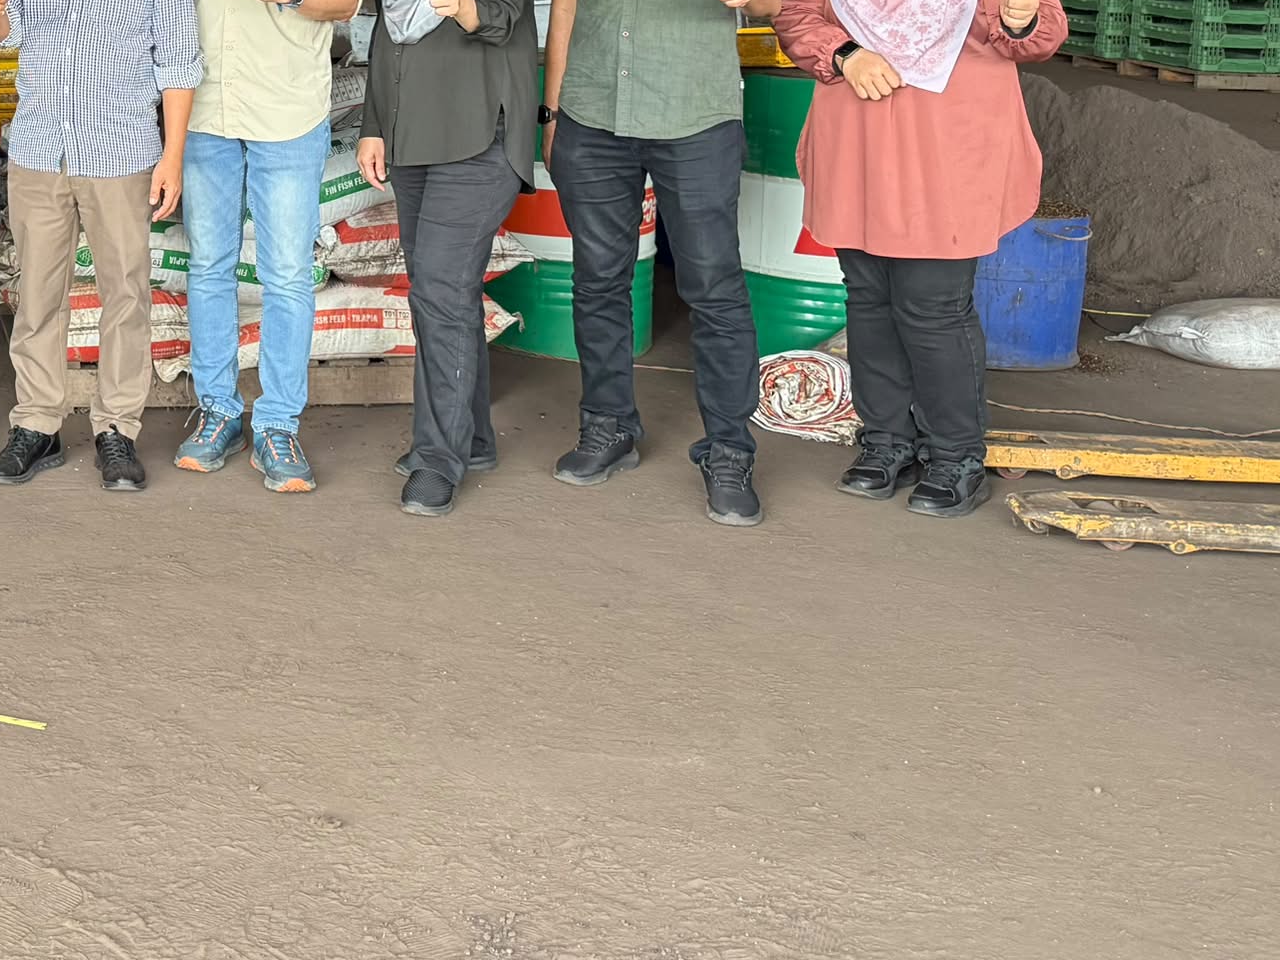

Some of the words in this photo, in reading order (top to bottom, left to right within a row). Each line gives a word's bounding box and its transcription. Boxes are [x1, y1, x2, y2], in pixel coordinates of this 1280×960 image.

[324, 184, 337, 196] FIN
[337, 180, 354, 192] FISH
[353, 175, 368, 187] FEE
[169, 255, 190, 266] APIA
[351, 313, 379, 323] TILAPIA
